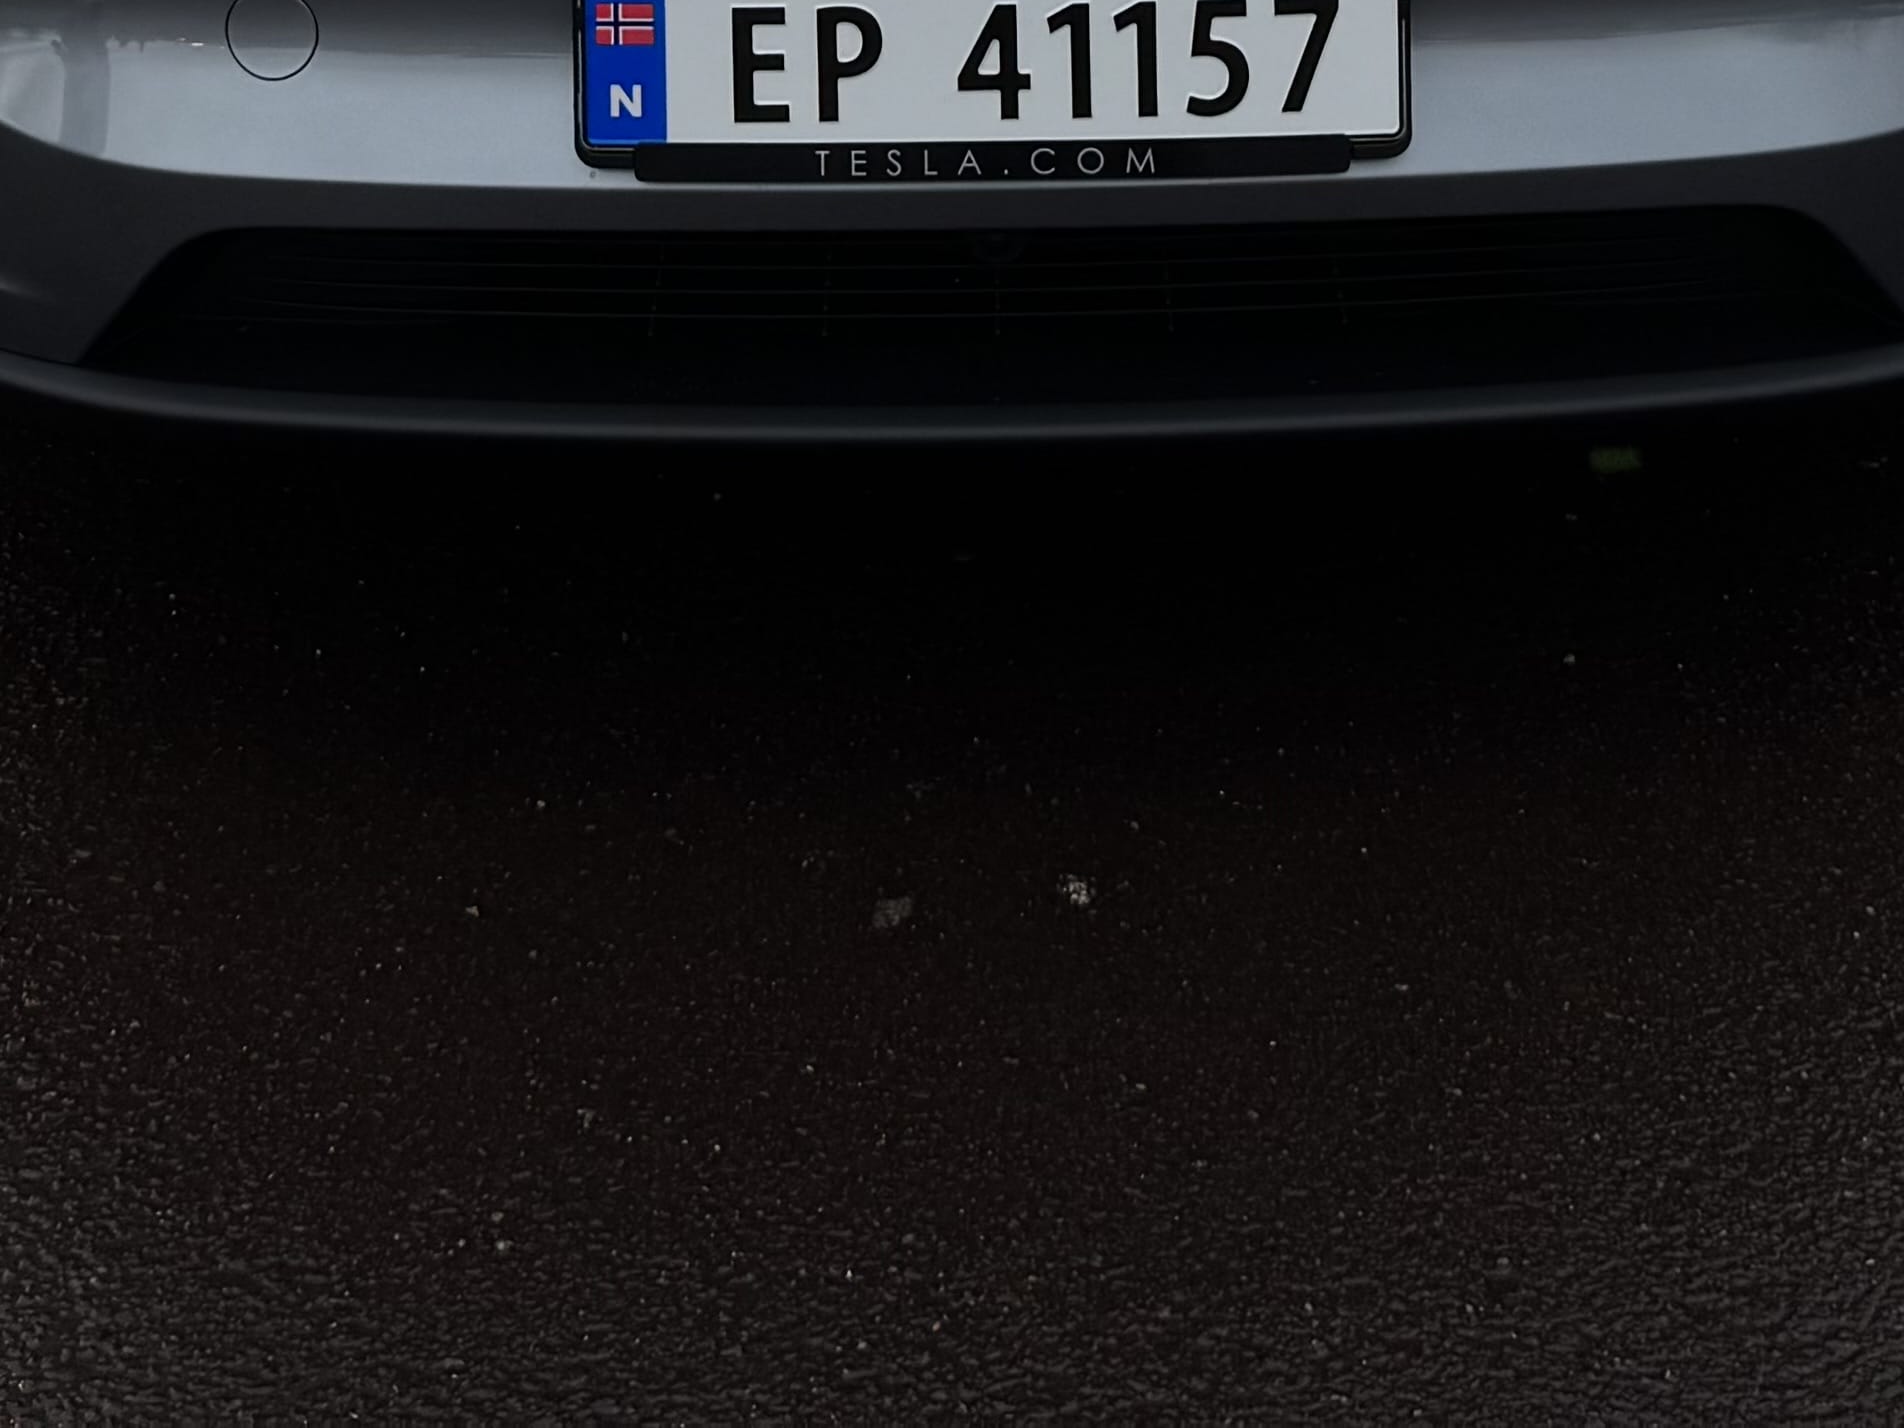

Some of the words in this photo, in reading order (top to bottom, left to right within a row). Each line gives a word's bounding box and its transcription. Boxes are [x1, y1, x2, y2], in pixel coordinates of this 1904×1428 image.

[730, 3, 884, 125] EP
[609, 83, 644, 120] N
[814, 147, 1160, 178] TESLA.COM
